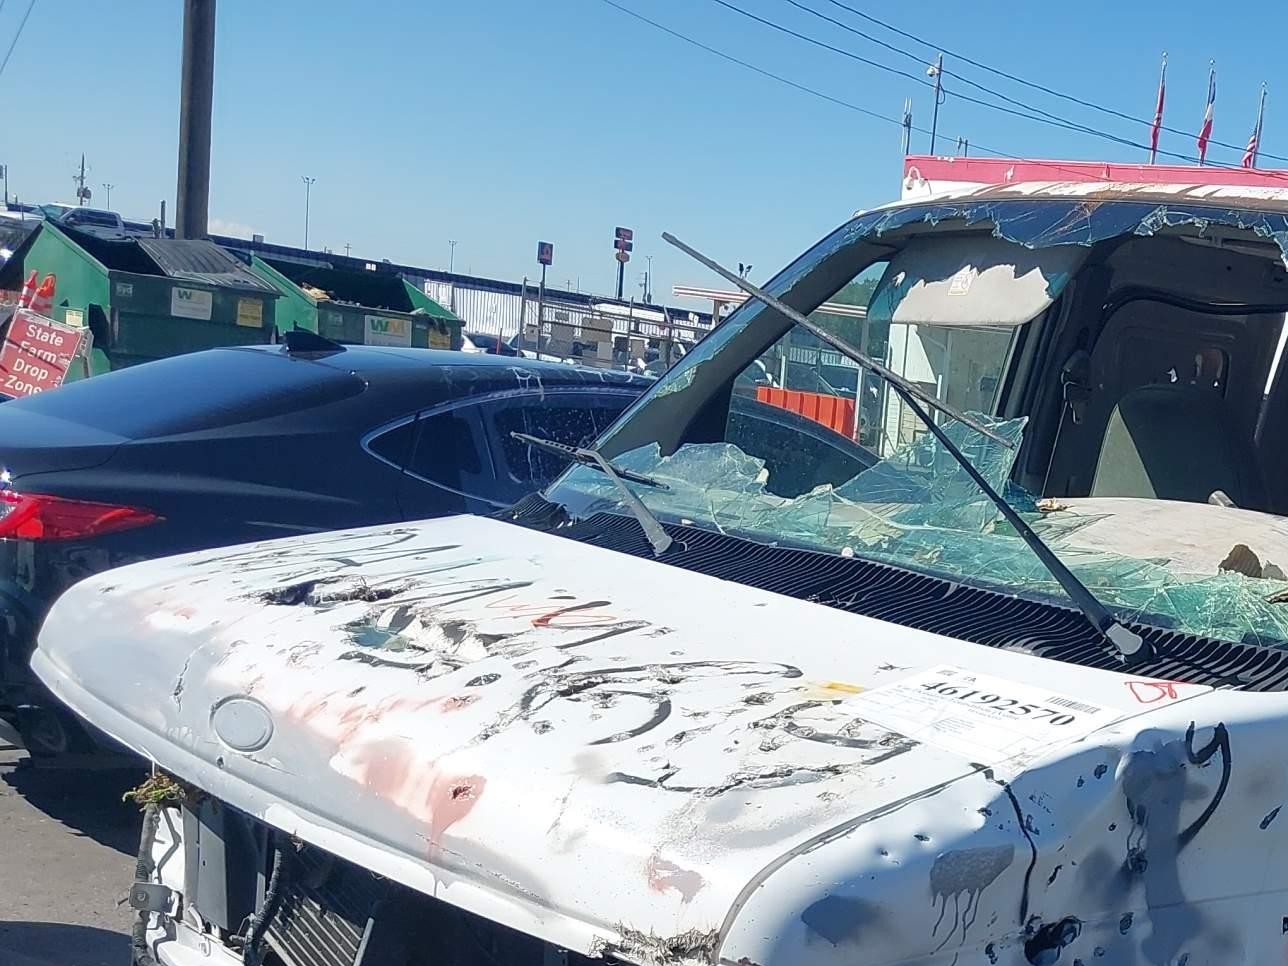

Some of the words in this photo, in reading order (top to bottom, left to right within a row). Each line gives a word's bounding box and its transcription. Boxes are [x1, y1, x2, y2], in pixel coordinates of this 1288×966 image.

[26, 324, 64, 346] State
[18, 341, 57, 363] Farm
[13, 358, 48, 381] Drop
[920, 681, 1076, 726] 46192570
